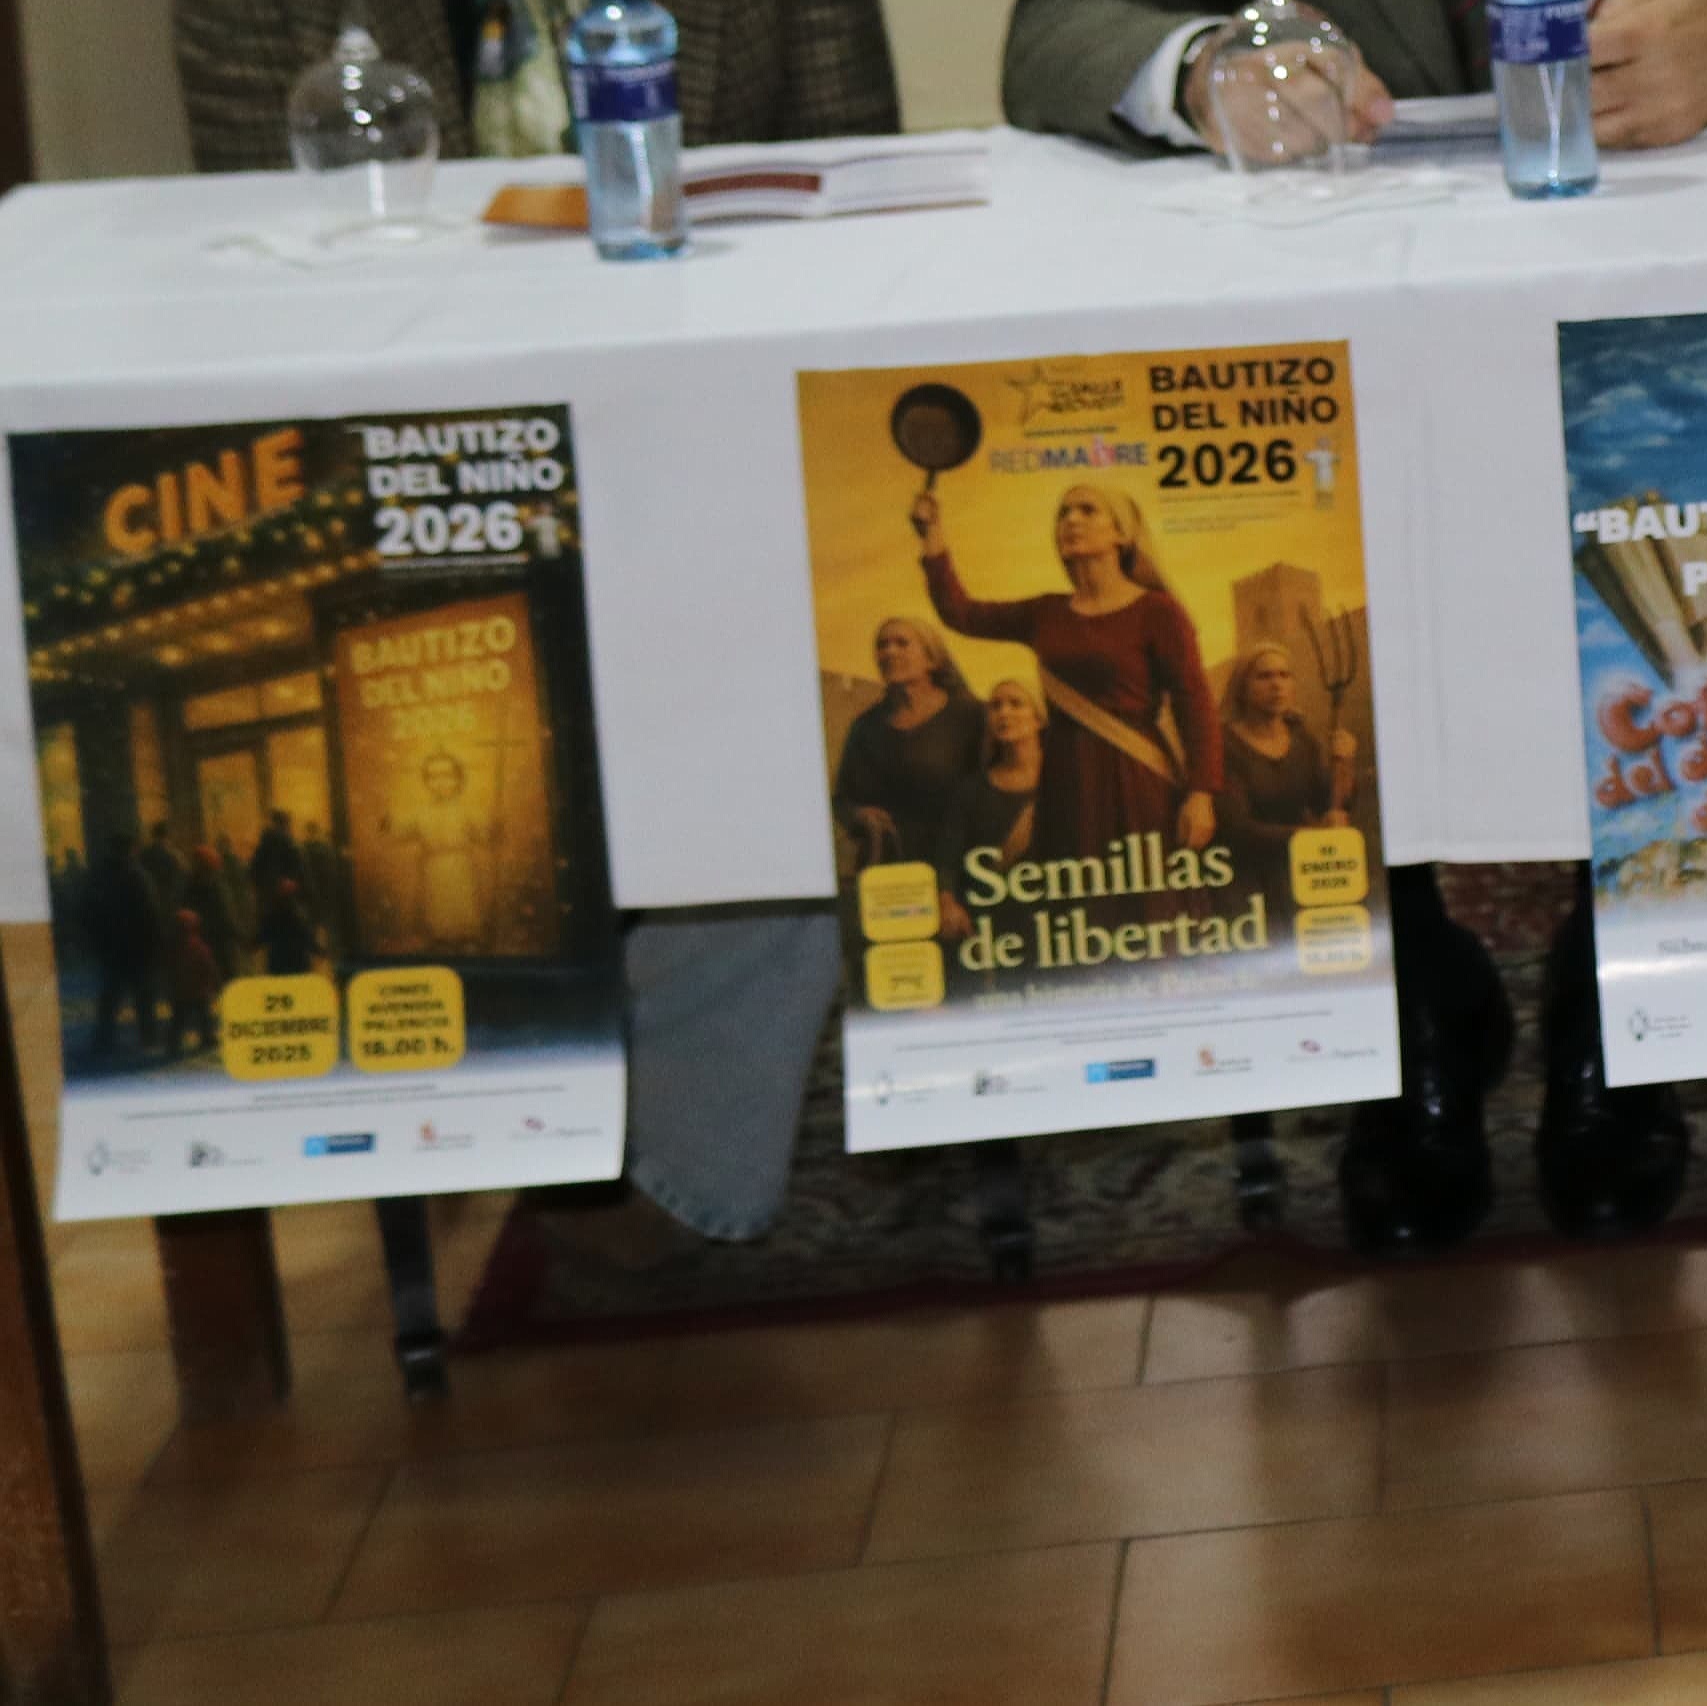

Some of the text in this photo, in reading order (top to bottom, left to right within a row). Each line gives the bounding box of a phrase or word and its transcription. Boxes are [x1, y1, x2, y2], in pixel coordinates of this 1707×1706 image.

[1150, 357, 1335, 393] BAUTIZO
[1152, 389, 1339, 432] DEL NIÑO
[362, 418, 561, 459] BAUTIZO
[1157, 439, 1297, 489] 2026
[104, 428, 304, 554] CINE
[368, 453, 565, 498] DEL NIÑO
[375, 501, 523, 553] 2026
[352, 616, 516, 675] BAUTIZO
[1596, 748, 1675, 807] del
[963, 831, 1234, 907] Semillas
[959, 915, 1024, 971] de
[1034, 893, 1269, 968] libertad
